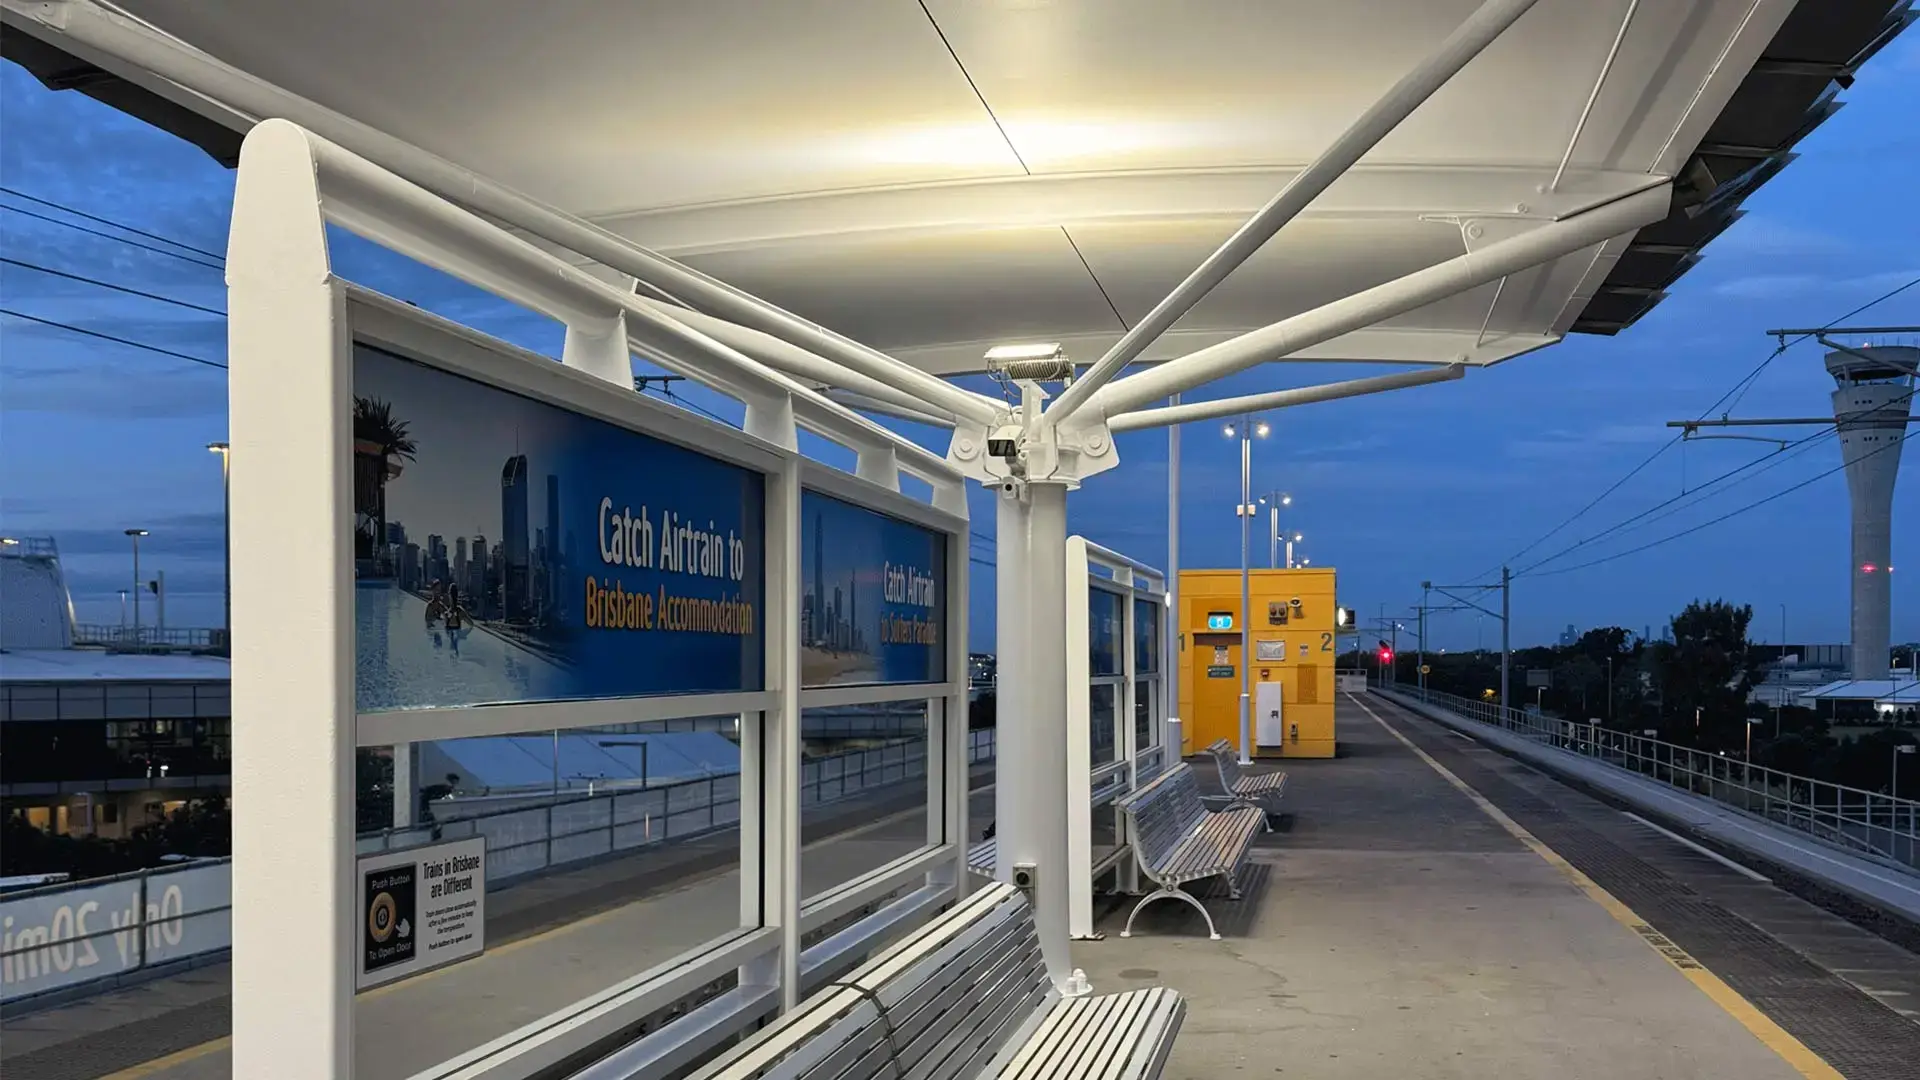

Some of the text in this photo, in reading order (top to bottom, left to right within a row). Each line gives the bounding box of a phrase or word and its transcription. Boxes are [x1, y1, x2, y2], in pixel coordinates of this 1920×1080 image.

[599, 496, 743, 582] Catch Airtrain to
[884, 560, 935, 608] Catch Airtrain
[586, 574, 753, 636] Brisbane Accommodation
[889, 611, 911, 644] Surfers
[913, 613, 936, 645] Paradise
[1321, 632, 1333, 652] 2
[424, 856, 480, 879] Trains in Brisbane
[372, 874, 410, 889] Push Button
[430, 876, 472, 898] are Different
[368, 941, 412, 960] To Open Door
